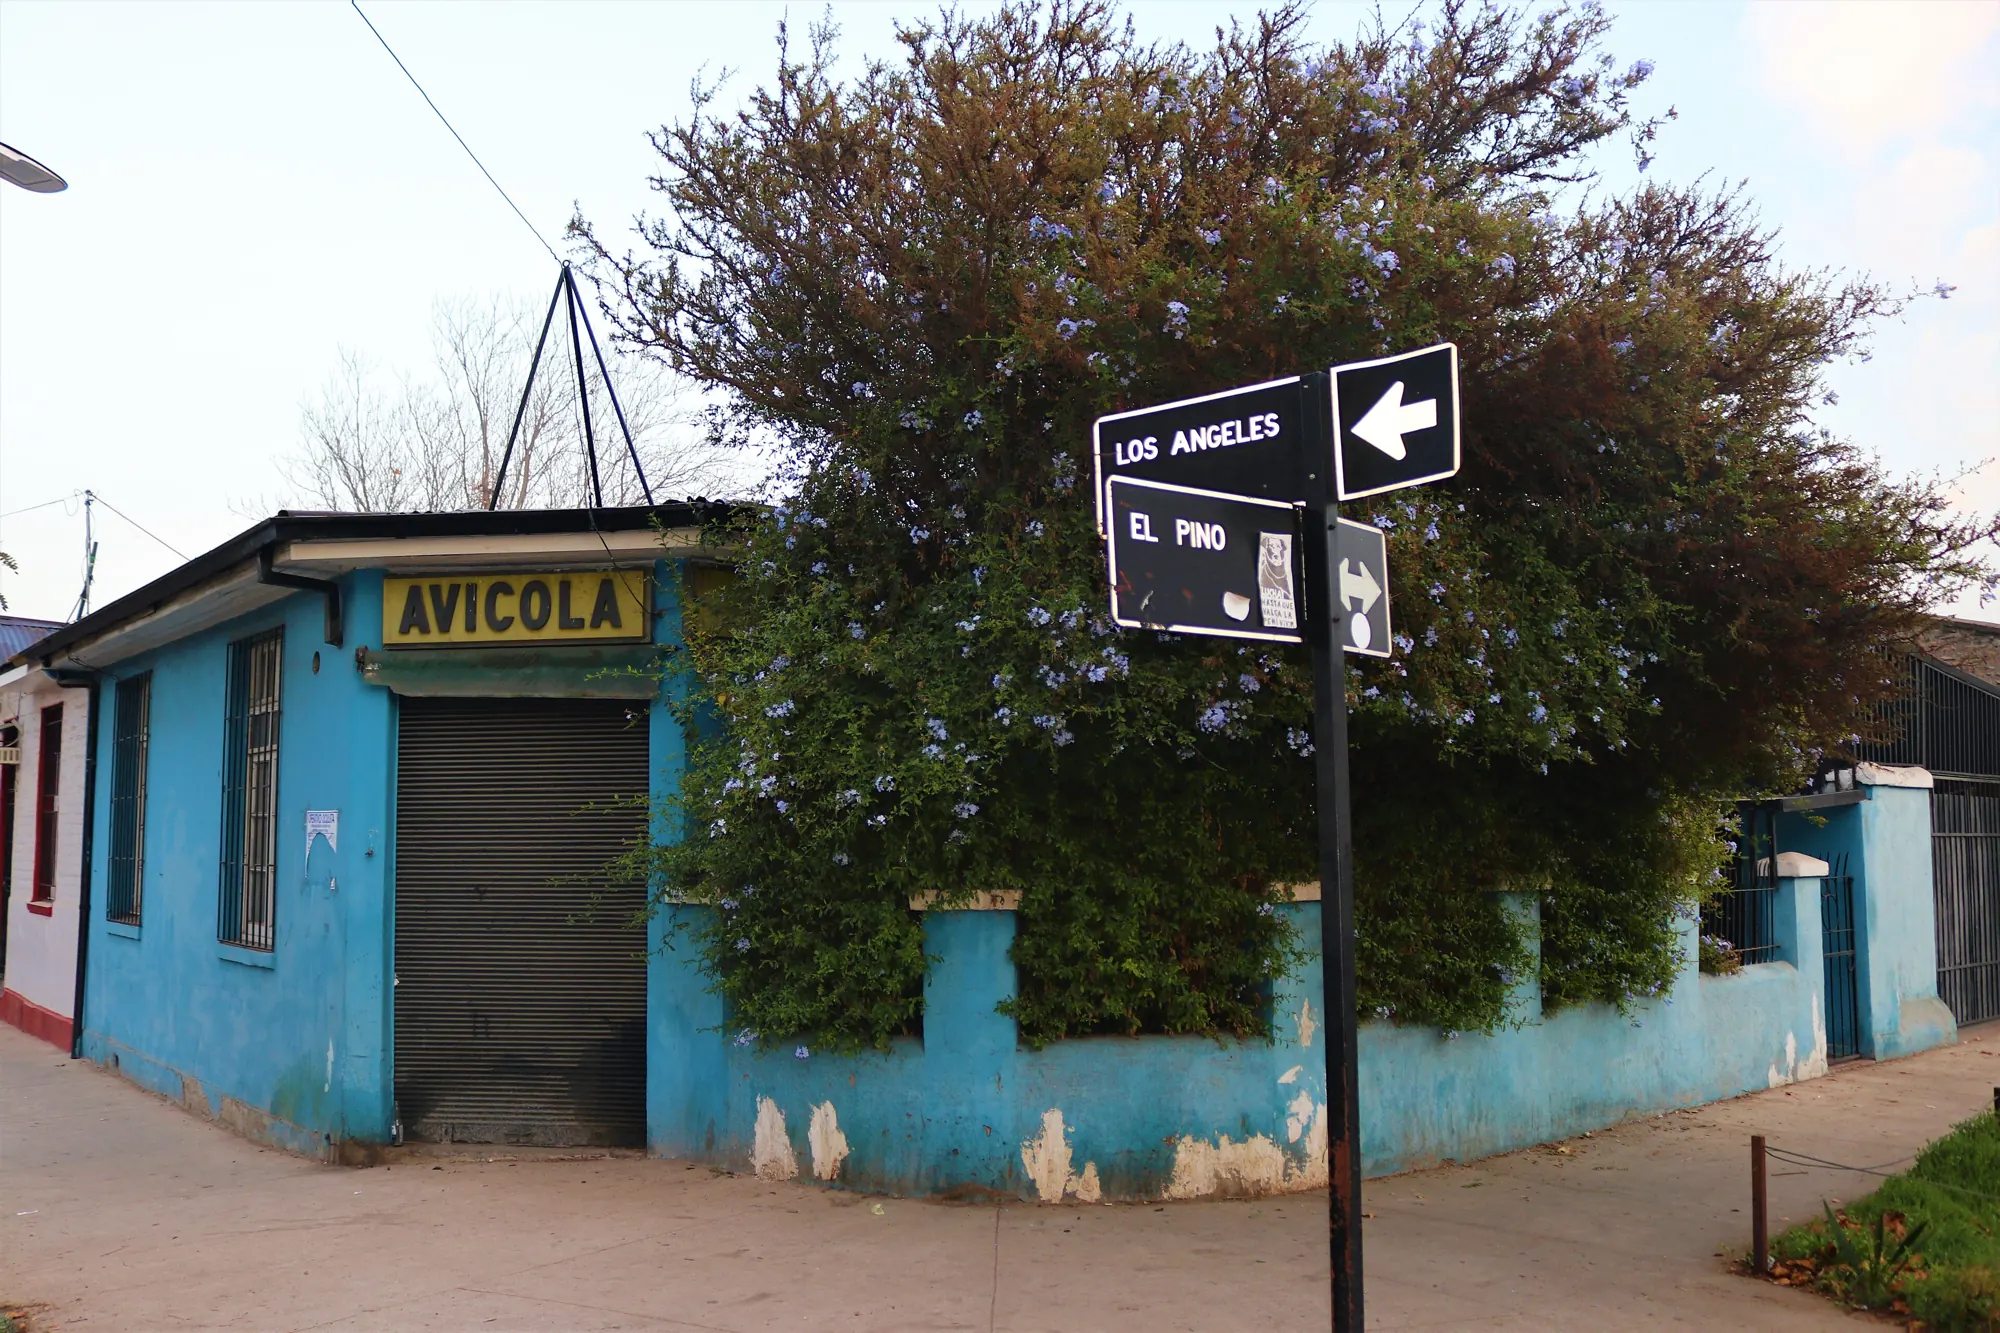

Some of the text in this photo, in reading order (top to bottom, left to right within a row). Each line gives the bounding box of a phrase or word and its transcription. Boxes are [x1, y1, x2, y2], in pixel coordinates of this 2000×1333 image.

[1115, 412, 1280, 466] LOS ANGELES
[1130, 512, 1226, 551] EL PINO
[398, 578, 622, 634] AVICOLA
